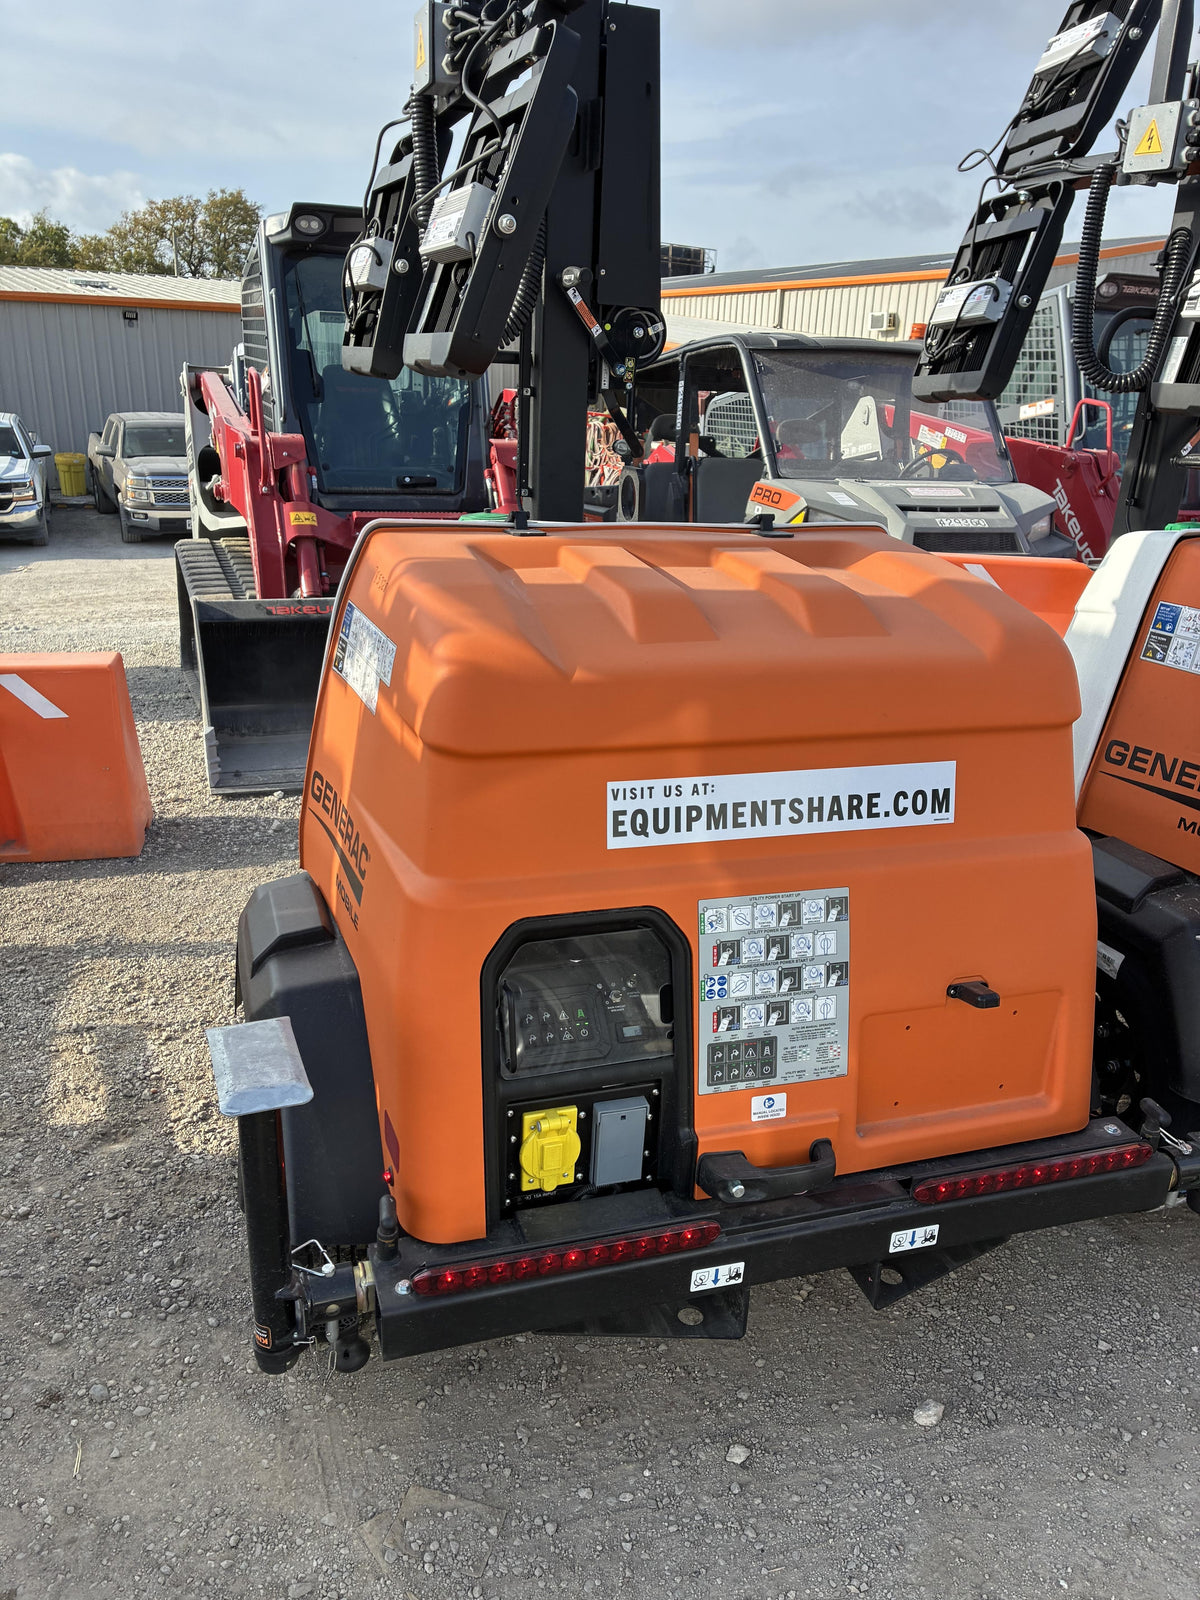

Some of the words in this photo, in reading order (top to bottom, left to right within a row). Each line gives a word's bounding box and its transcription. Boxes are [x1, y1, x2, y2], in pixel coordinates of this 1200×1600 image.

[1122, 284, 1160, 296] TAKEU
[753, 485, 782, 504] PRO
[266, 605, 334, 615] TAKEU
[1104, 739, 1200, 793] GENE
[611, 786, 655, 801] VISIT
[663, 784, 683, 798] US
[691, 782, 715, 796] AT:
[310, 770, 369, 881] GENERAC
[612, 787, 951, 838] EQUIPMENTSHARE.COM
[336, 873, 359, 932] MOBILE
